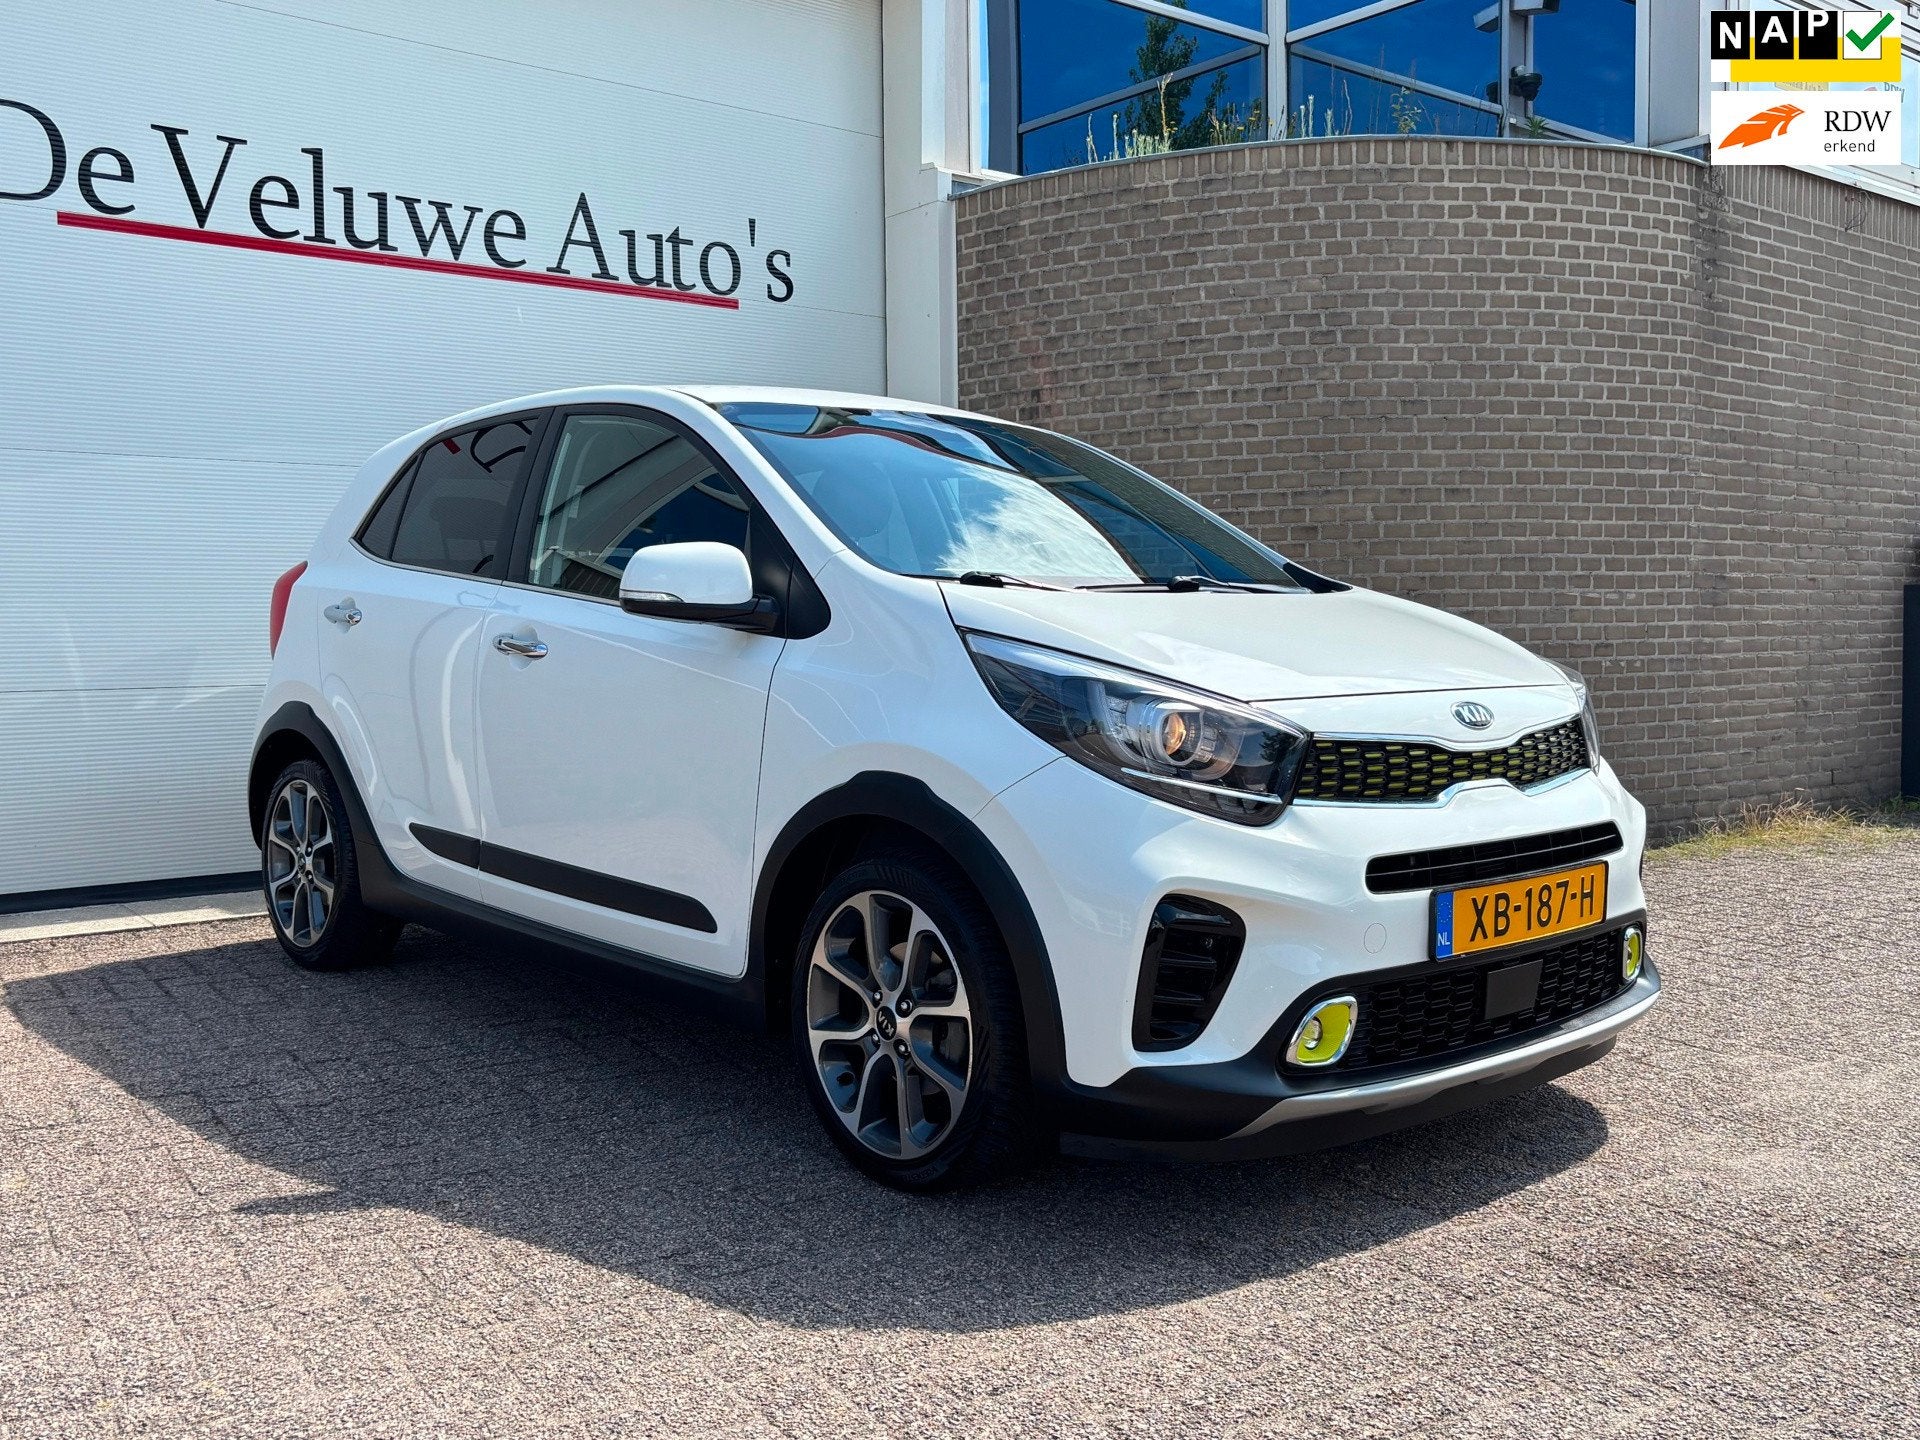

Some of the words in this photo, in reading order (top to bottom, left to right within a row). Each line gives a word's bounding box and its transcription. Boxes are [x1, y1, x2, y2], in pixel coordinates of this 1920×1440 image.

[0, 98, 136, 215] De
[150, 123, 527, 268] Veluwe
[546, 191, 794, 302] Auto's
[1456, 705, 1491, 723] KIA
[1469, 873, 1595, 942] XB-187-H
[1437, 932, 1451, 947] NL
[878, 1010, 895, 1037] KIA
